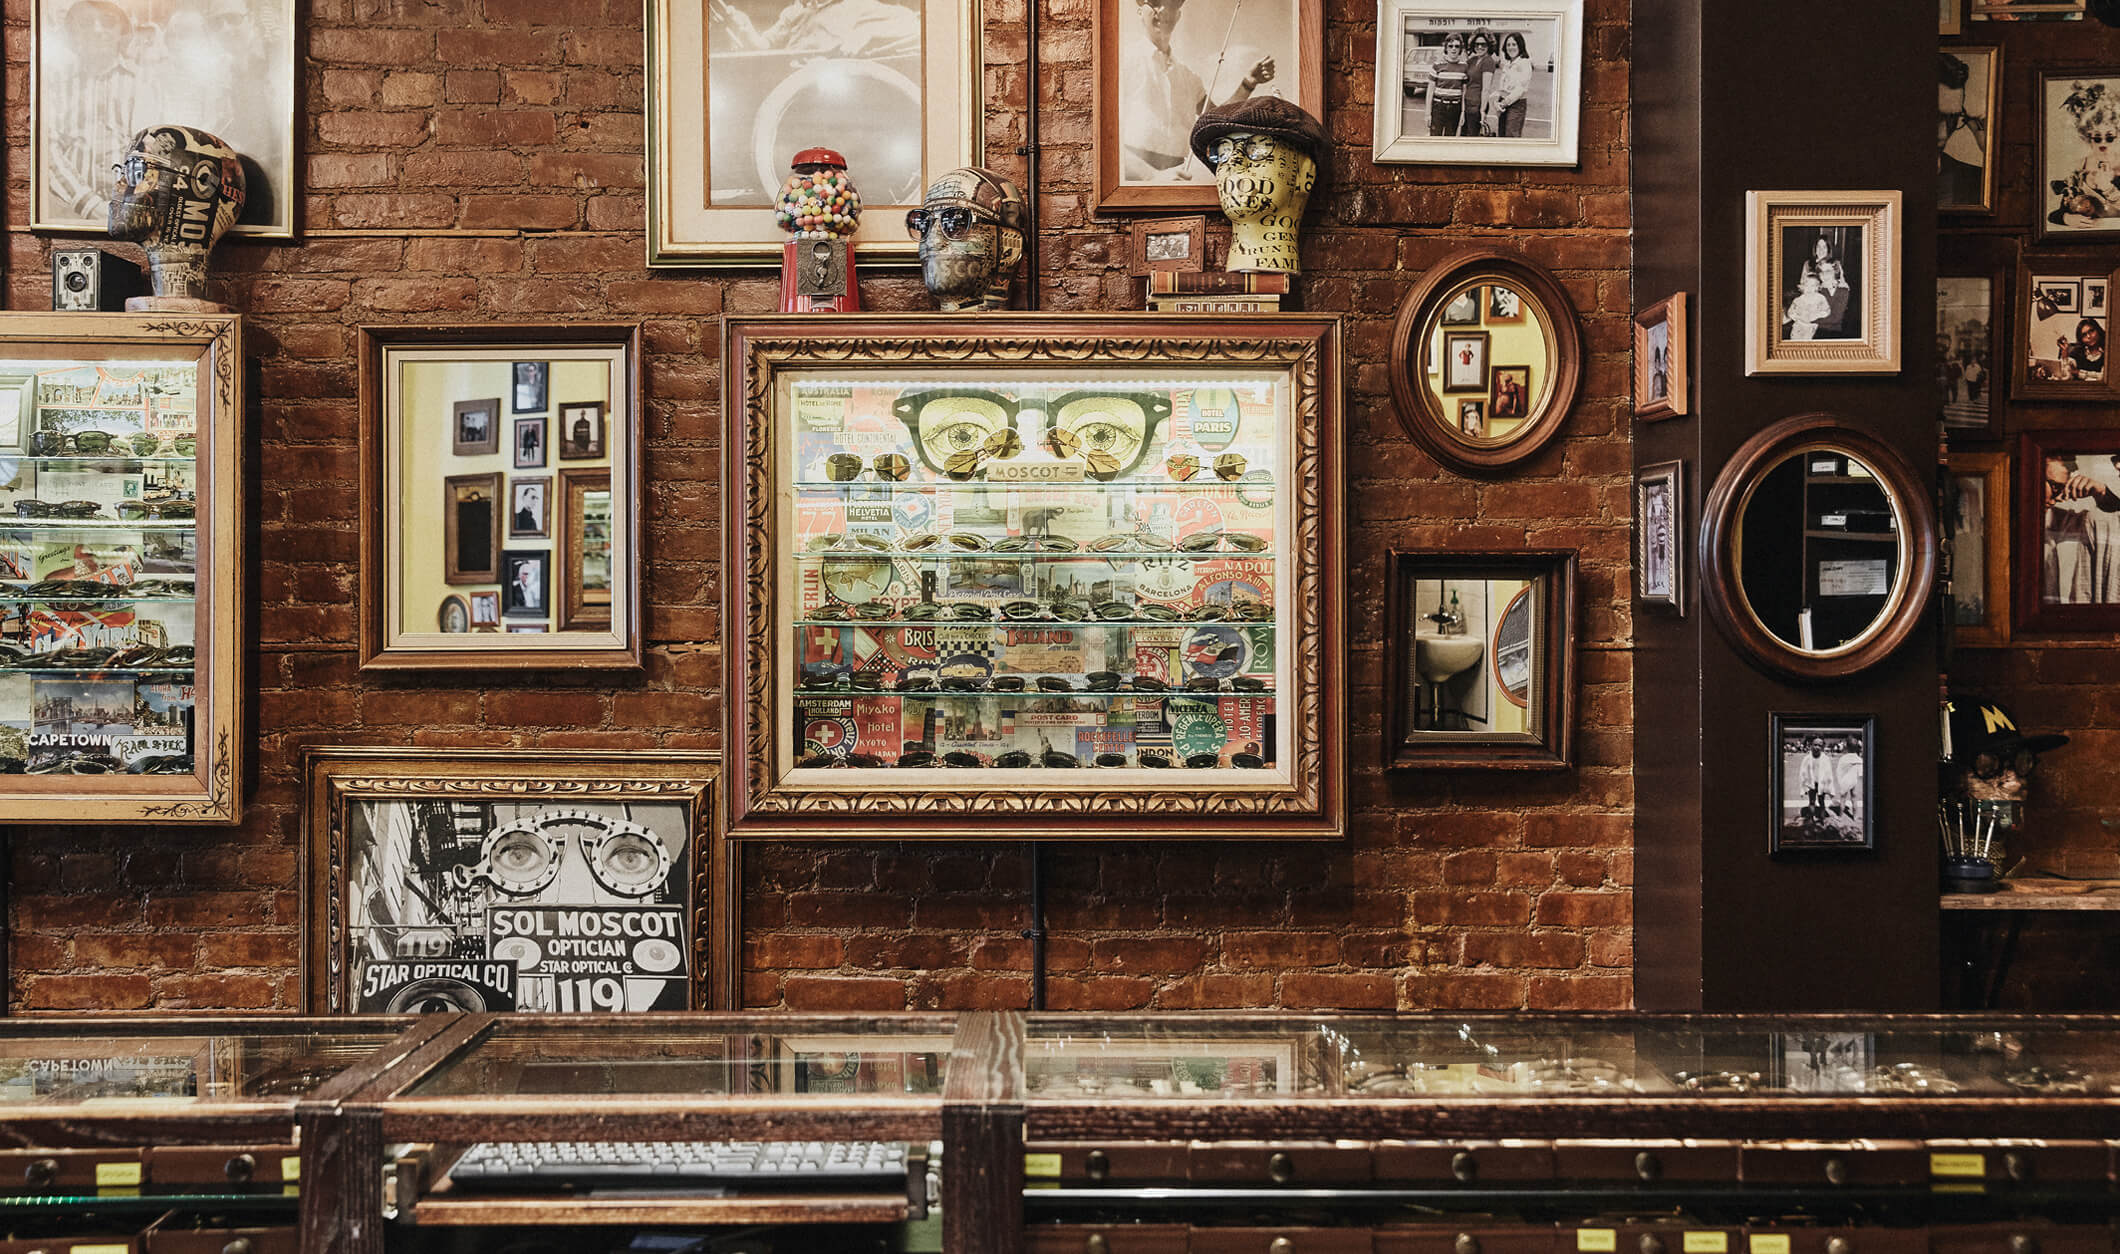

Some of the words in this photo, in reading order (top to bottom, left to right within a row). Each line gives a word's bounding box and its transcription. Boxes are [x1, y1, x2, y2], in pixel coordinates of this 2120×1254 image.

[1193, 422, 1232, 434] PARIS
[994, 466, 1060, 478] MOSCOT
[849, 508, 890, 517] HELVETIA
[1224, 561, 1273, 574] NAPOLI
[1197, 570, 1243, 591] ALFONSO
[803, 569, 819, 617] ERLIN
[1139, 584, 1193, 598] BARCELONA
[1005, 629, 1073, 648] ISLAND
[799, 699, 852, 708] AMSTERDAM
[856, 703, 895, 717] Miyako
[1223, 700, 1235, 731] HOTEL
[867, 721, 895, 735] Hotel
[28, 733, 112, 747] CAPETOWN
[858, 738, 887, 747] KYOTO
[1078, 731, 1137, 743] ROCKEFELLE
[1092, 743, 1126, 753] CENTER
[492, 911, 554, 937] SOL
[558, 911, 678, 938] MOSCOT
[398, 935, 448, 957] 119
[547, 939, 627, 957] OPTICIAN
[539, 960, 569, 974] STAR
[571, 960, 622, 974] OPTICAL
[363, 963, 410, 998] STAR
[413, 964, 481, 983] OPTICAL
[483, 964, 513, 999] CO.
[558, 977, 625, 1013] 119
